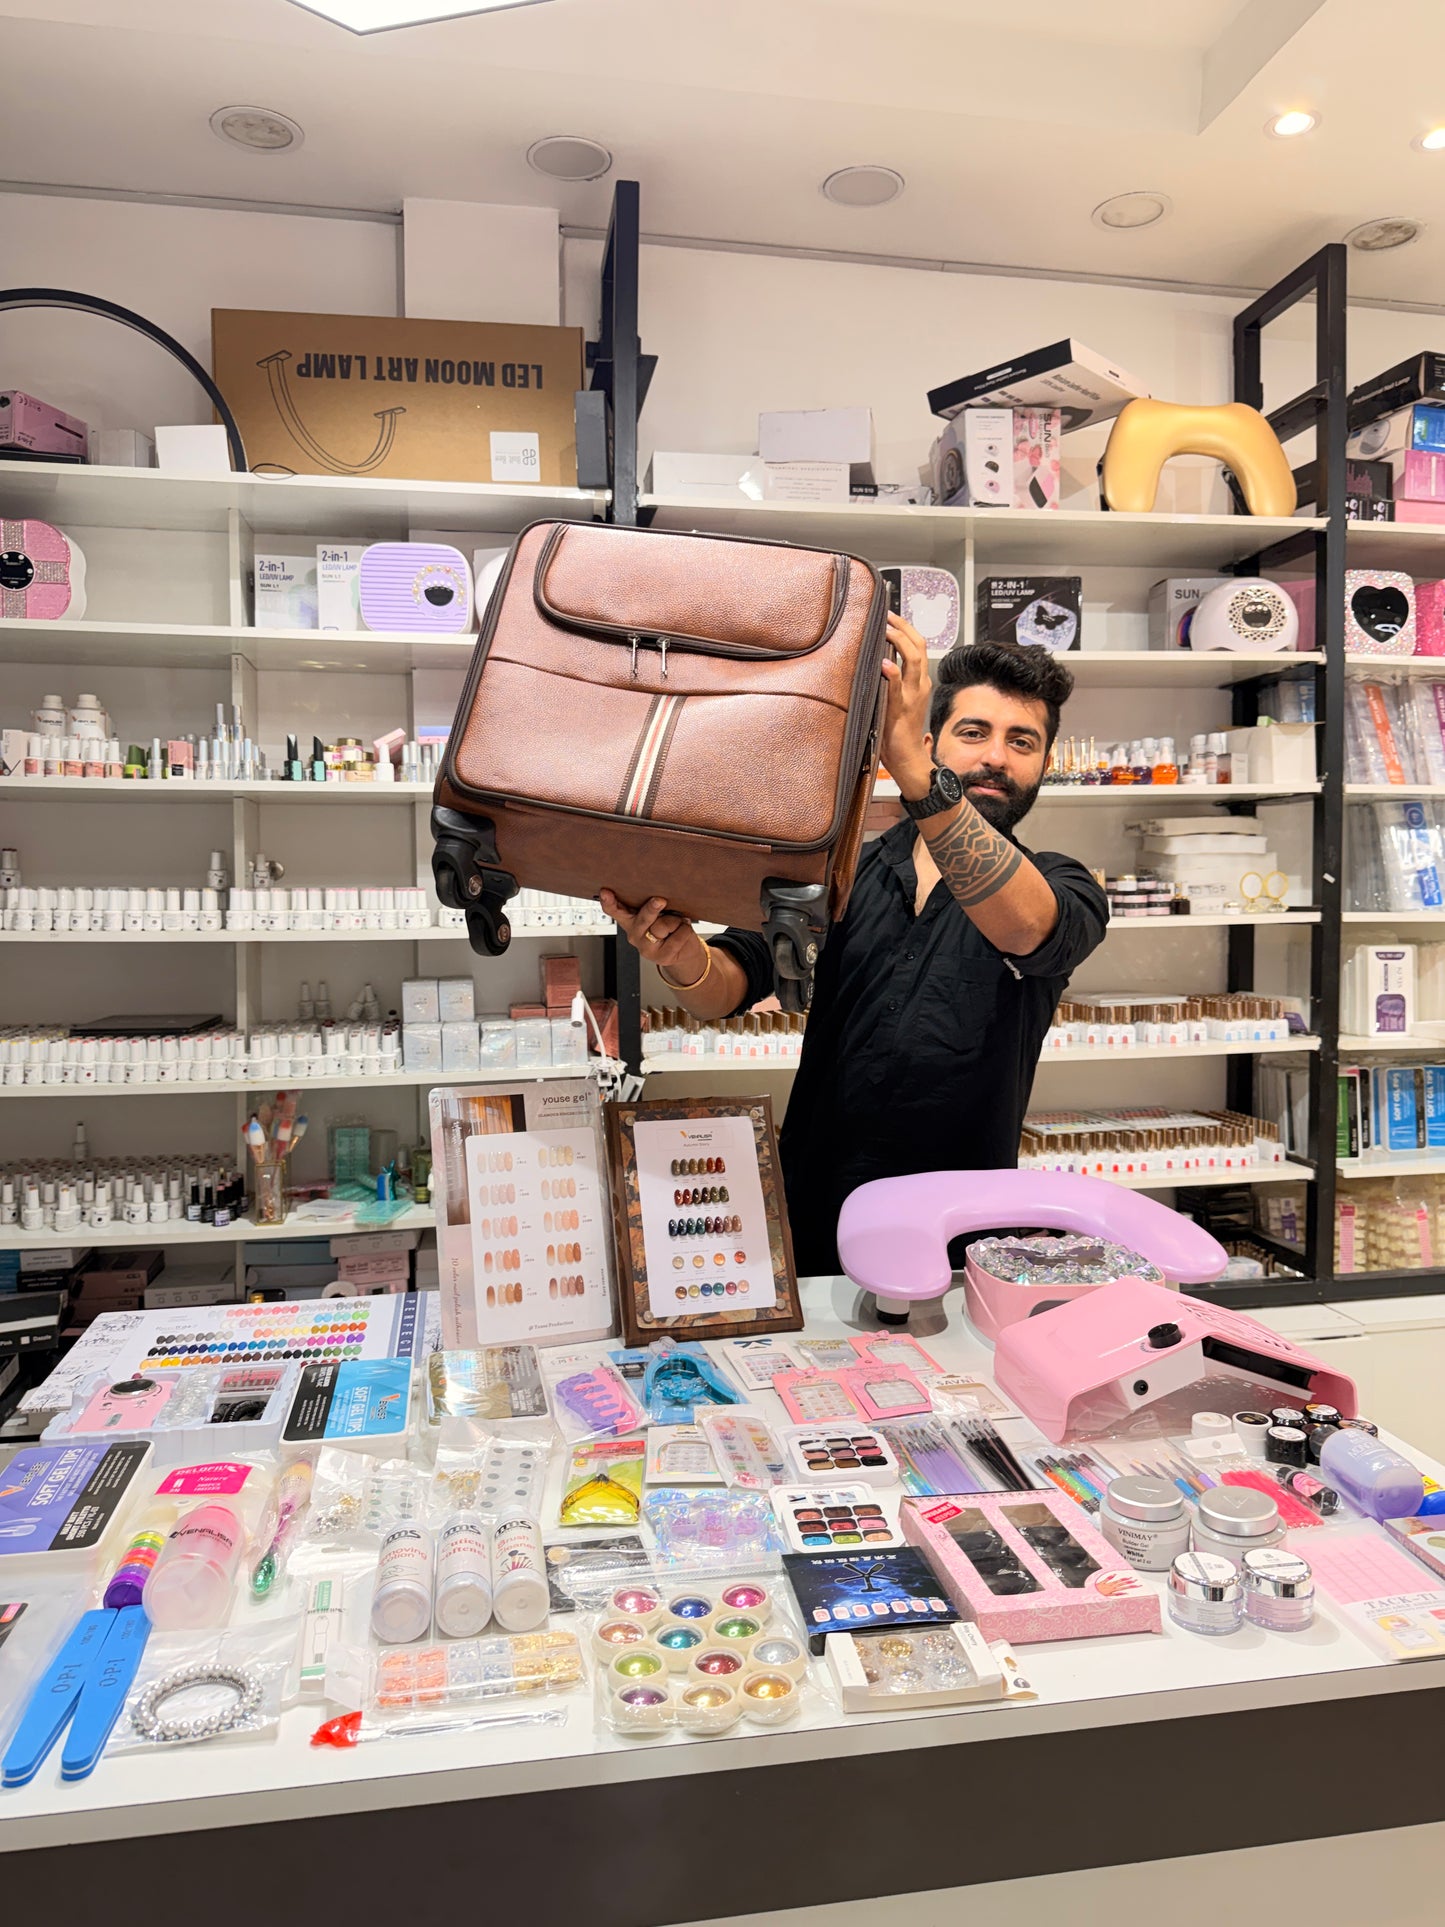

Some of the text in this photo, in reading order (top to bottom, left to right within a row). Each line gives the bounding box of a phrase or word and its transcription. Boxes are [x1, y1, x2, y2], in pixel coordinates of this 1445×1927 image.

[296, 352, 543, 389] LED MOON ART LAMP
[1043, 413, 1052, 443] SUN
[322, 550, 349, 563] 2-in-1
[259, 560, 286, 573] 2-in-1
[279, 574, 295, 582] LAMP
[990, 589, 1035, 597] LED/UV LAMP
[1174, 589, 1200, 600] SUN
[1427, 1085, 1435, 1101] GEL
[542, 1096, 571, 1106] youse
[1393, 1102, 1402, 1121] SOFT
[1427, 1100, 1436, 1118] SOFT
[401, 1298, 416, 1353] PERFECT
[346, 1386, 370, 1433] SOFT GEL TIPS
[31, 1485, 59, 1506] SOFT
[48, 1465, 73, 1483] GEL
[62, 1448, 83, 1465] TIPS
[1117, 1527, 1153, 1541] VINIMAY
[497, 1535, 530, 1549] Brush
[1126, 1549, 1145, 1558] White
